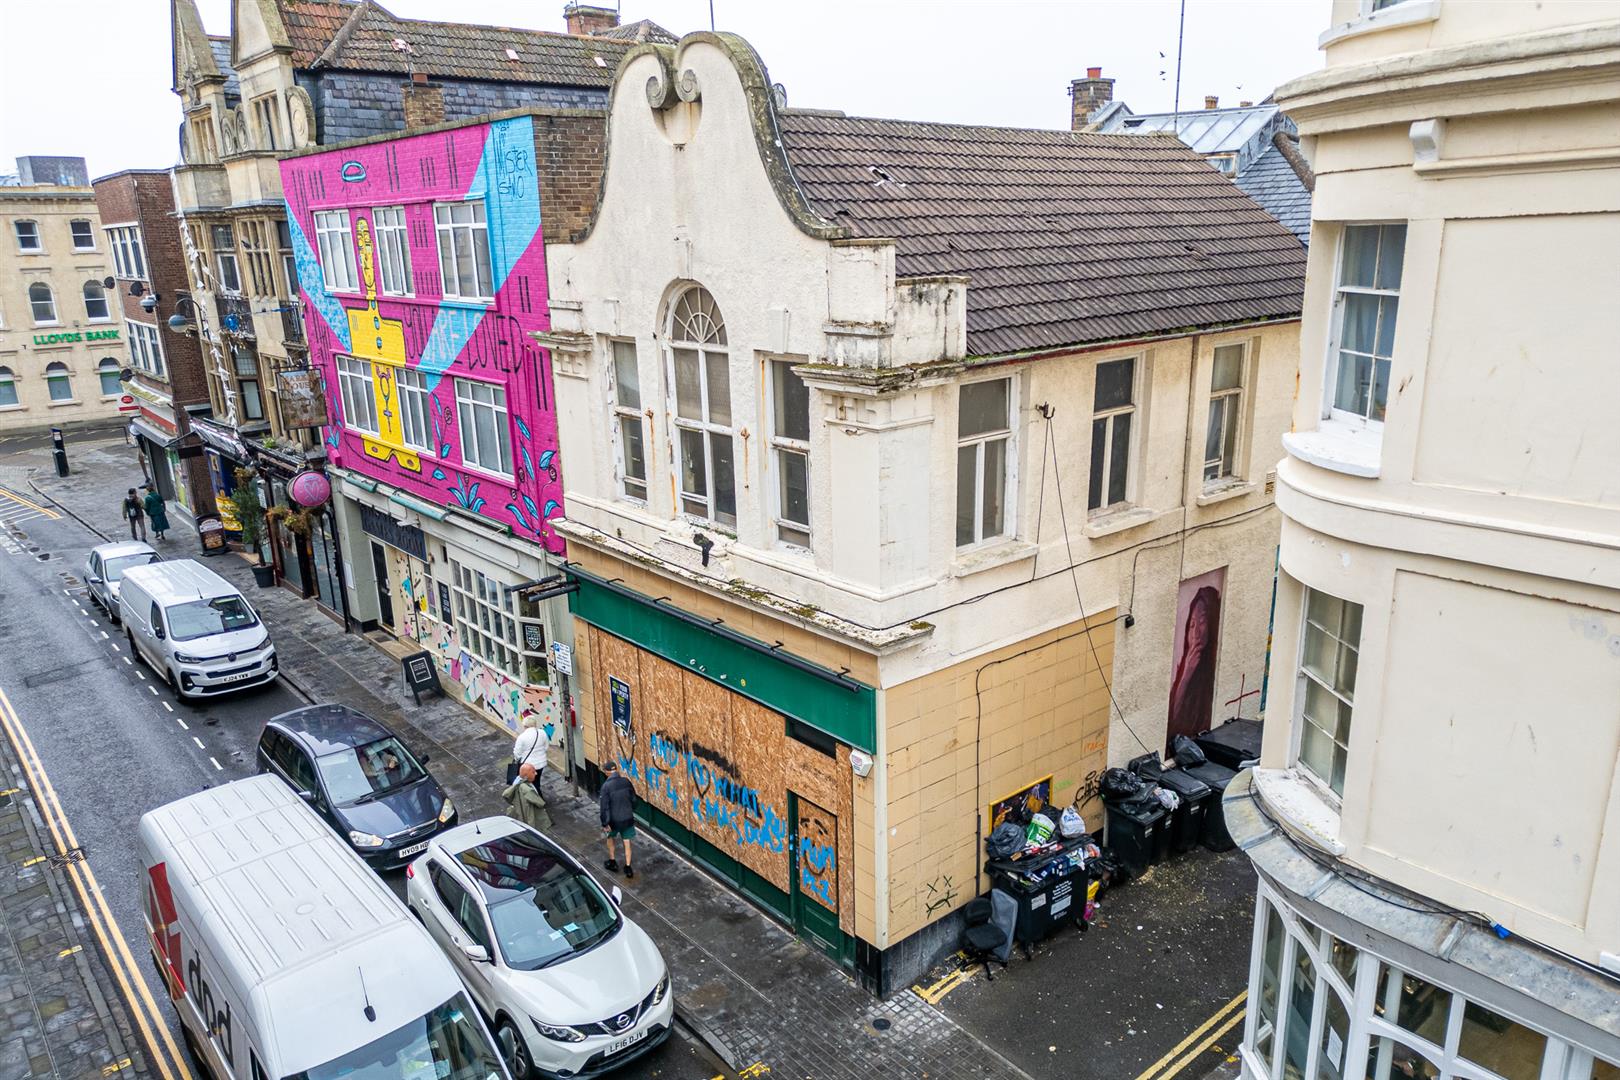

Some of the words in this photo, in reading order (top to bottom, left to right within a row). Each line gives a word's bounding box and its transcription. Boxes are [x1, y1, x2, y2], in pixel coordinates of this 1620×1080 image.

[33, 332, 82, 346] LLOYDS
[85, 329, 121, 342] BANK
[403, 304, 435, 359] YOU
[424, 309, 463, 365] ARE
[463, 309, 525, 373] LOVED
[651, 733, 678, 768] AND
[711, 771, 760, 818] WHAT
[666, 778, 679, 810] 4
[188, 948, 235, 1069] dpd
[610, 1040, 628, 1053] LF16
[629, 1031, 644, 1044] DJV
